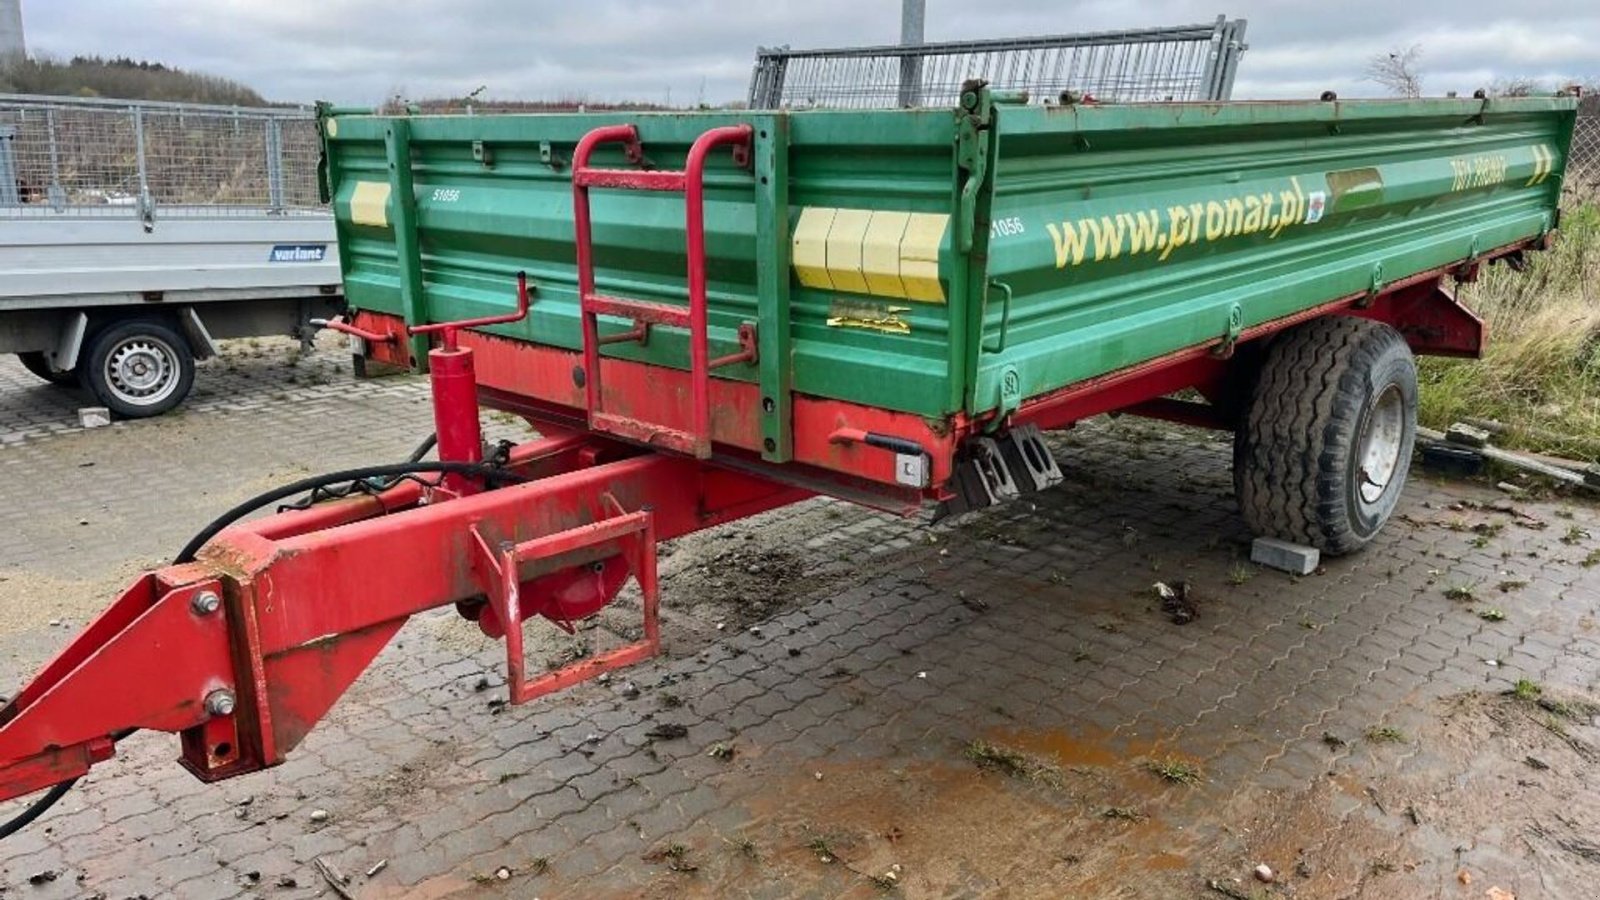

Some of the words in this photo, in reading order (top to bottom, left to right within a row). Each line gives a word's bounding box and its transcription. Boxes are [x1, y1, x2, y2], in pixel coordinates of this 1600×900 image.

[432, 188, 460, 201] 51056
[1046, 176, 1304, 269] www.pronar.pl
[274, 246, 322, 261] variant
